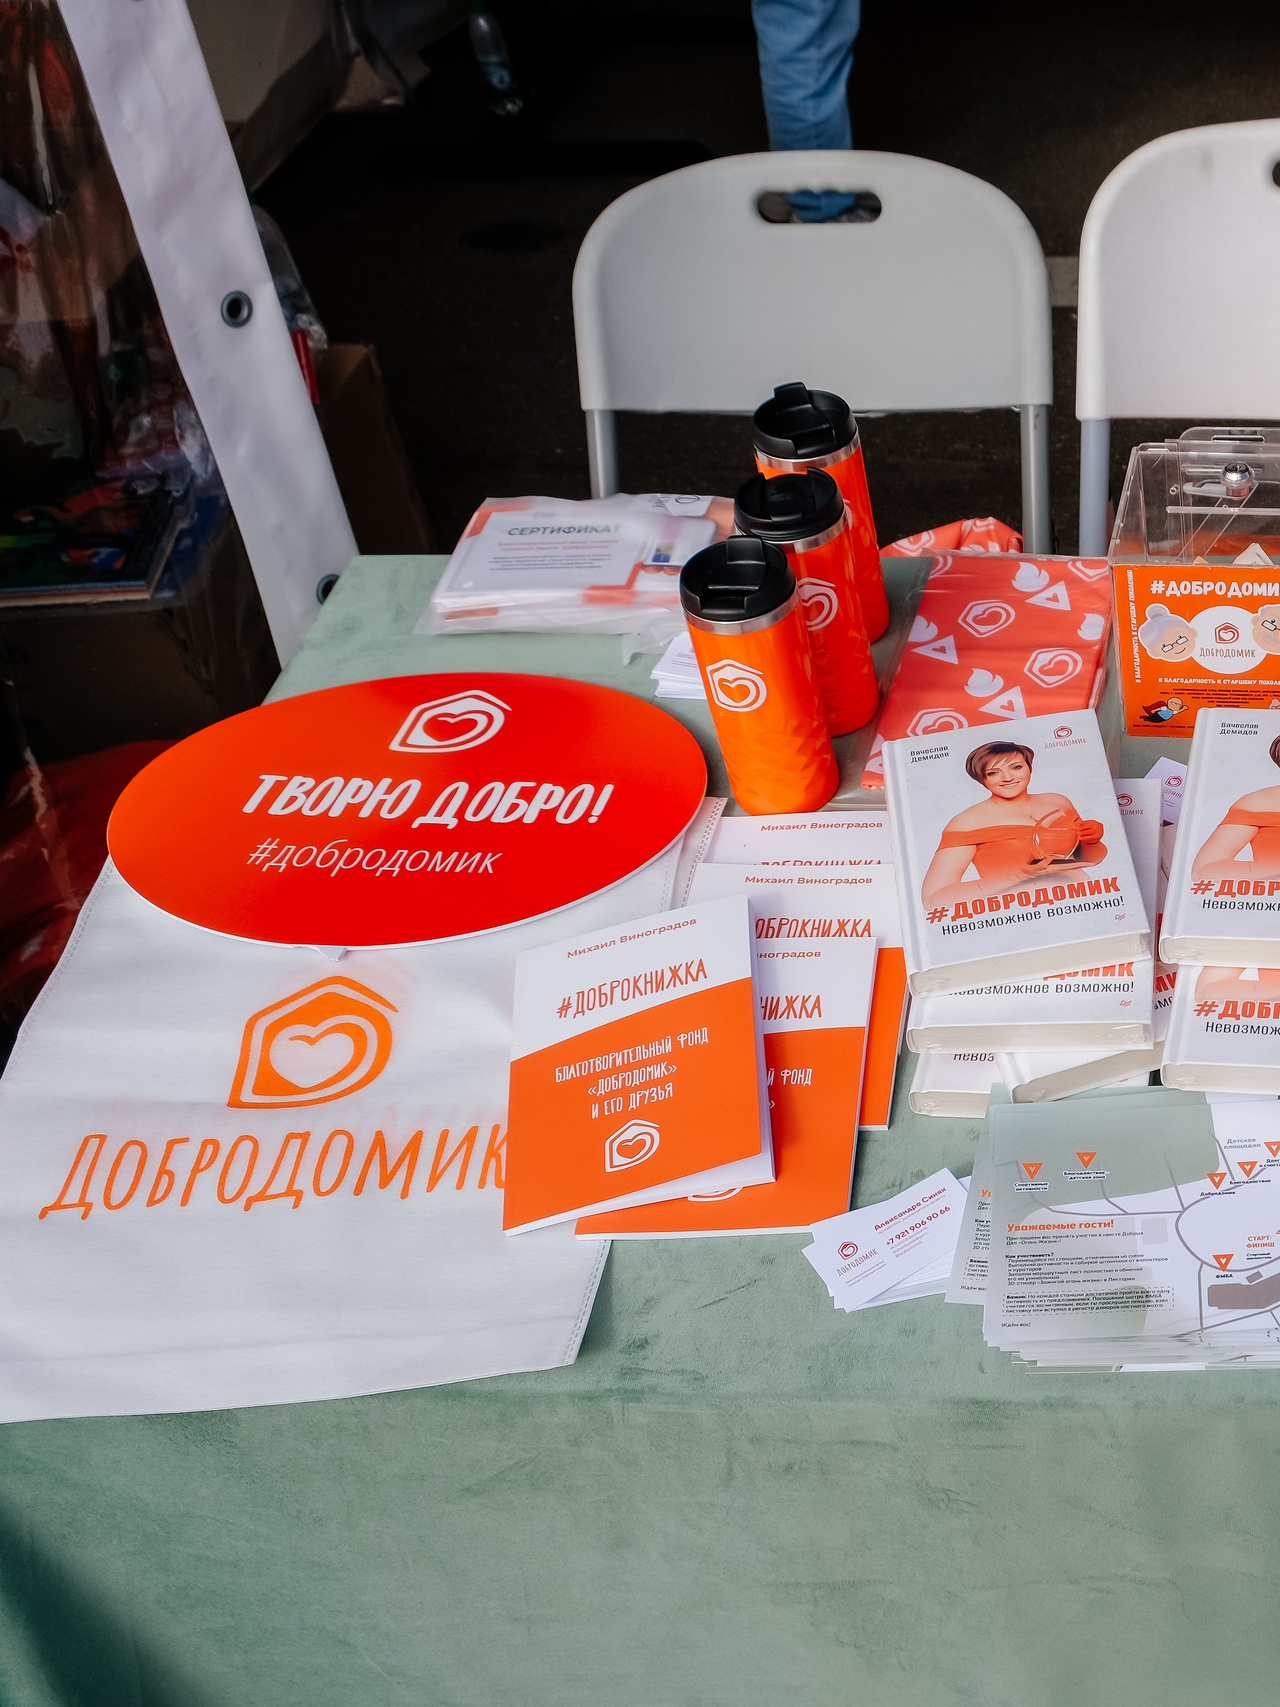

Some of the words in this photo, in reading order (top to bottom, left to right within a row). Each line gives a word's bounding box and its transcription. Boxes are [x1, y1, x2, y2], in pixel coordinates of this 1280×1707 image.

[508, 524, 620, 536] СЕРТИФИКАТ
[1199, 646, 1256, 659] ДОБРОДОМИК
[910, 745, 949, 757] Вячеслав
[910, 751, 950, 764] Демидов
[1043, 738, 1087, 750] ДОБРОДОМИК
[242, 774, 422, 819] ТВОРЮ
[411, 781, 615, 829] ДОБРО!
[810, 822, 883, 830] Виноградов
[247, 836, 504, 877] #добродомик
[745, 876, 793, 884] Михаил
[797, 877, 873, 886] Виноградов
[925, 876, 1121, 924] #ДОБРОДОМИК
[755, 918, 872, 938] ОБРОКНИЖКА
[941, 908, 1042, 936] Невозможное
[1046, 896, 1125, 919] возможно!
[566, 938, 617, 959] Михаил
[619, 918, 697, 945] Виноградов
[556, 958, 708, 1019] #ДОБРОКНИЖКА
[1055, 981, 1135, 993] возможно!
[555, 1035, 673, 1083] БЛАГОТВОРИТЕЛЬНЫЙ
[677, 1026, 709, 1047] ФОНД
[587, 1062, 677, 1096] «ДОБРОДОМИК»
[780, 1068, 813, 1087] ФОНД
[592, 1103, 599, 1119] И
[604, 1098, 623, 1116] ЕГО
[628, 1082, 673, 1112] ДРУЗЬЯ
[39, 1122, 506, 1221] ДОБРОДОМИК
[874, 1202, 922, 1231] Александра
[886, 1237, 895, 1246] +7
[894, 1229, 910, 1242] 921
[909, 1219, 927, 1232] 906
[926, 1212, 939, 1222] 90
[939, 1205, 951, 1215] 66
[1006, 1222, 1077, 1233] Уважаемые
[1079, 1219, 1115, 1230] гости!
[836, 1248, 879, 1278] ДОБРОДОМИК
